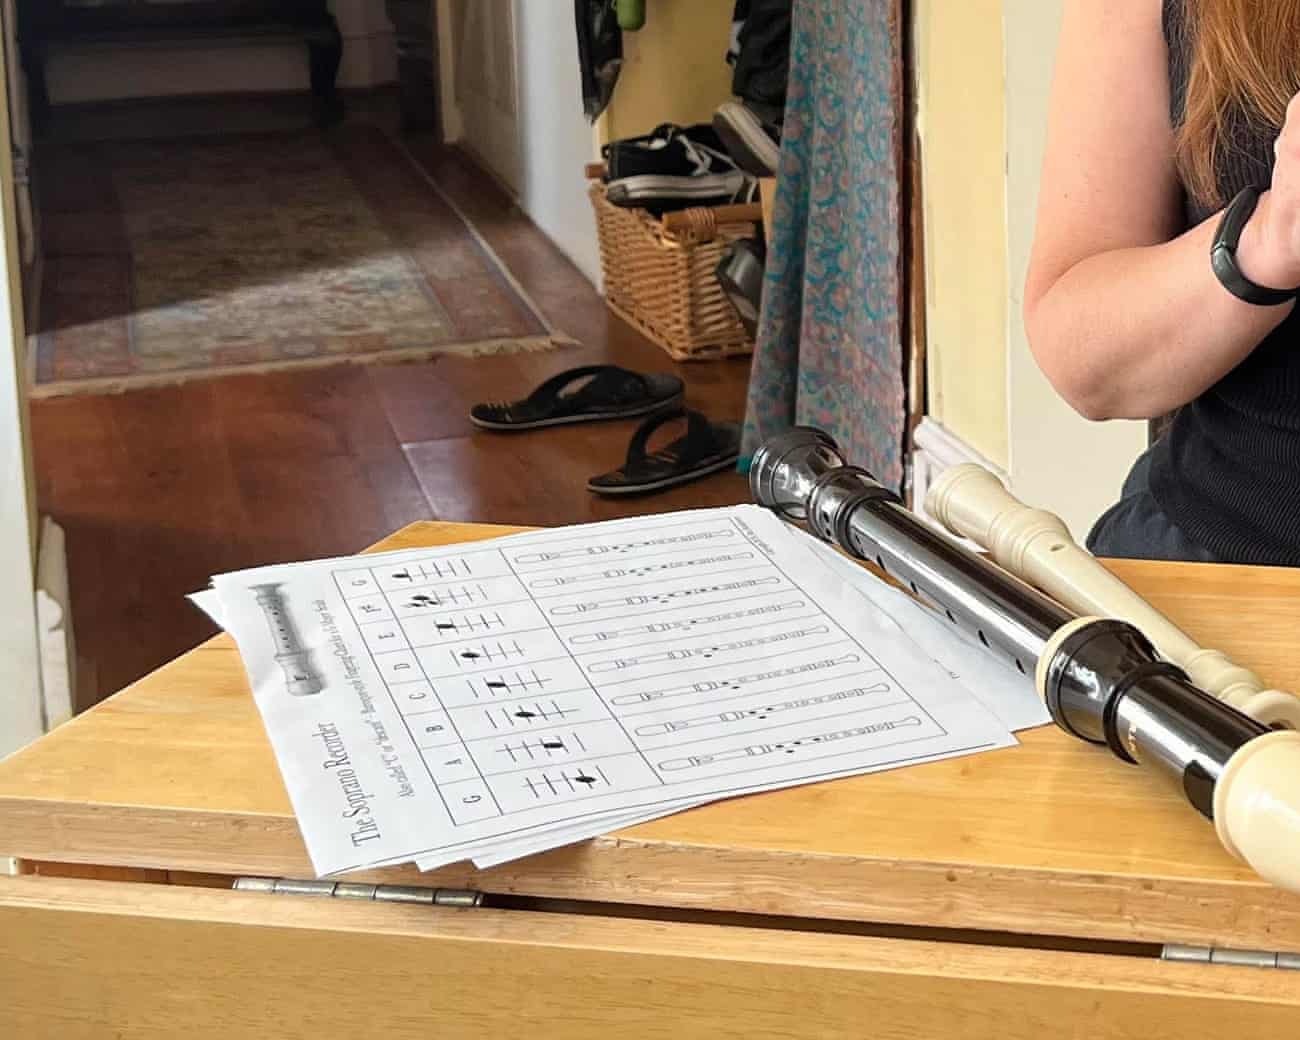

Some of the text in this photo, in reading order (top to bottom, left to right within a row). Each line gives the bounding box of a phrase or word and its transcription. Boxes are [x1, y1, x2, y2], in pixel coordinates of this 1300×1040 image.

[392, 662, 411, 671] D
[424, 723, 445, 733] B
[311, 721, 382, 848] The Soprano Recorder
